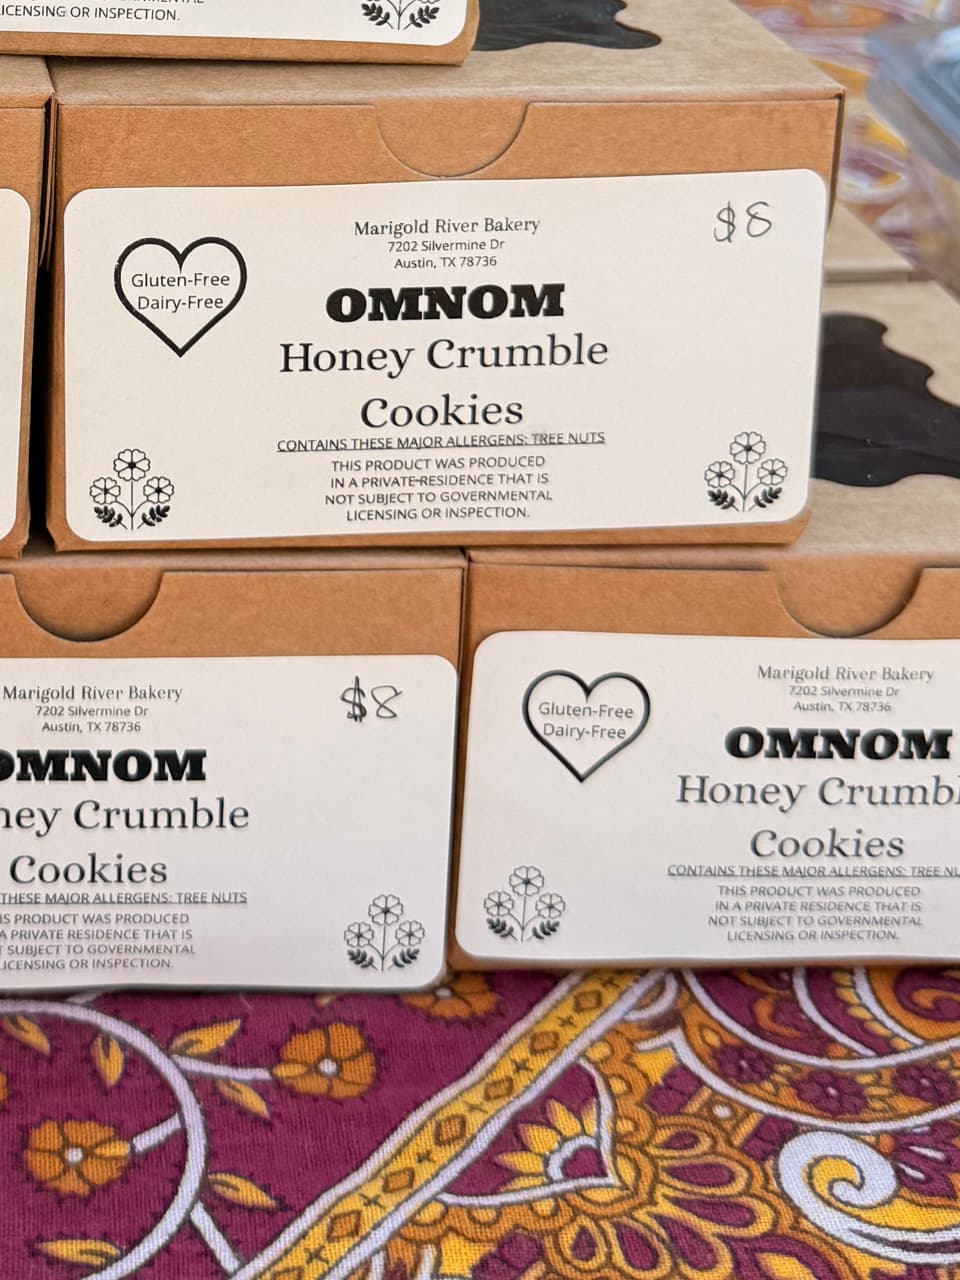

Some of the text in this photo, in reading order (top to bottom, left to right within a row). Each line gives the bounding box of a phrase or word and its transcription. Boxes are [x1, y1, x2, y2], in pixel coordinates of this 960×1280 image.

[69, 6, 90, 18] OR
[94, 6, 180, 21] INSPECTION.
[354, 216, 540, 240] Marigold River Bakery
[388, 238, 505, 252] 7202 Silvermine Dr
[394, 255, 497, 270] Austin, TX 78736
[131, 270, 230, 289] Gluten-Free
[137, 293, 224, 314] Dairy-Free
[325, 281, 565, 323] OMNOM
[279, 331, 609, 382] Honey Crumble
[360, 390, 524, 429] Cookies
[277, 431, 605, 451] CONTAINS THESE MAJOR ALLERGENS: TREE NUTS
[756, 664, 935, 685] Marigold River Bakery
[2, 684, 182, 704] Marigold River Bakery
[340, 676, 404, 723] $8
[788, 684, 901, 697] 7202 Silvermine Dr
[35, 705, 149, 716] 7202 Silvermine Dr
[537, 701, 635, 718] Gluten-Free
[792, 700, 892, 713] Austin, TX 78736
[41, 721, 141, 733] Austin, TX 78736
[542, 723, 628, 742] Dairy-Free
[723, 725, 954, 763] OMNOM
[674, 774, 808, 813] Honey
[73, 796, 249, 829] Crumble
[749, 824, 906, 859] Cookies
[9, 850, 167, 885] Cookies
[0, 892, 41, 903] THESE
[45, 892, 89, 904] MAJOR
[92, 891, 172, 903] ALLERGENS:
[175, 892, 207, 903] TREE
[211, 891, 247, 903] NUTS
